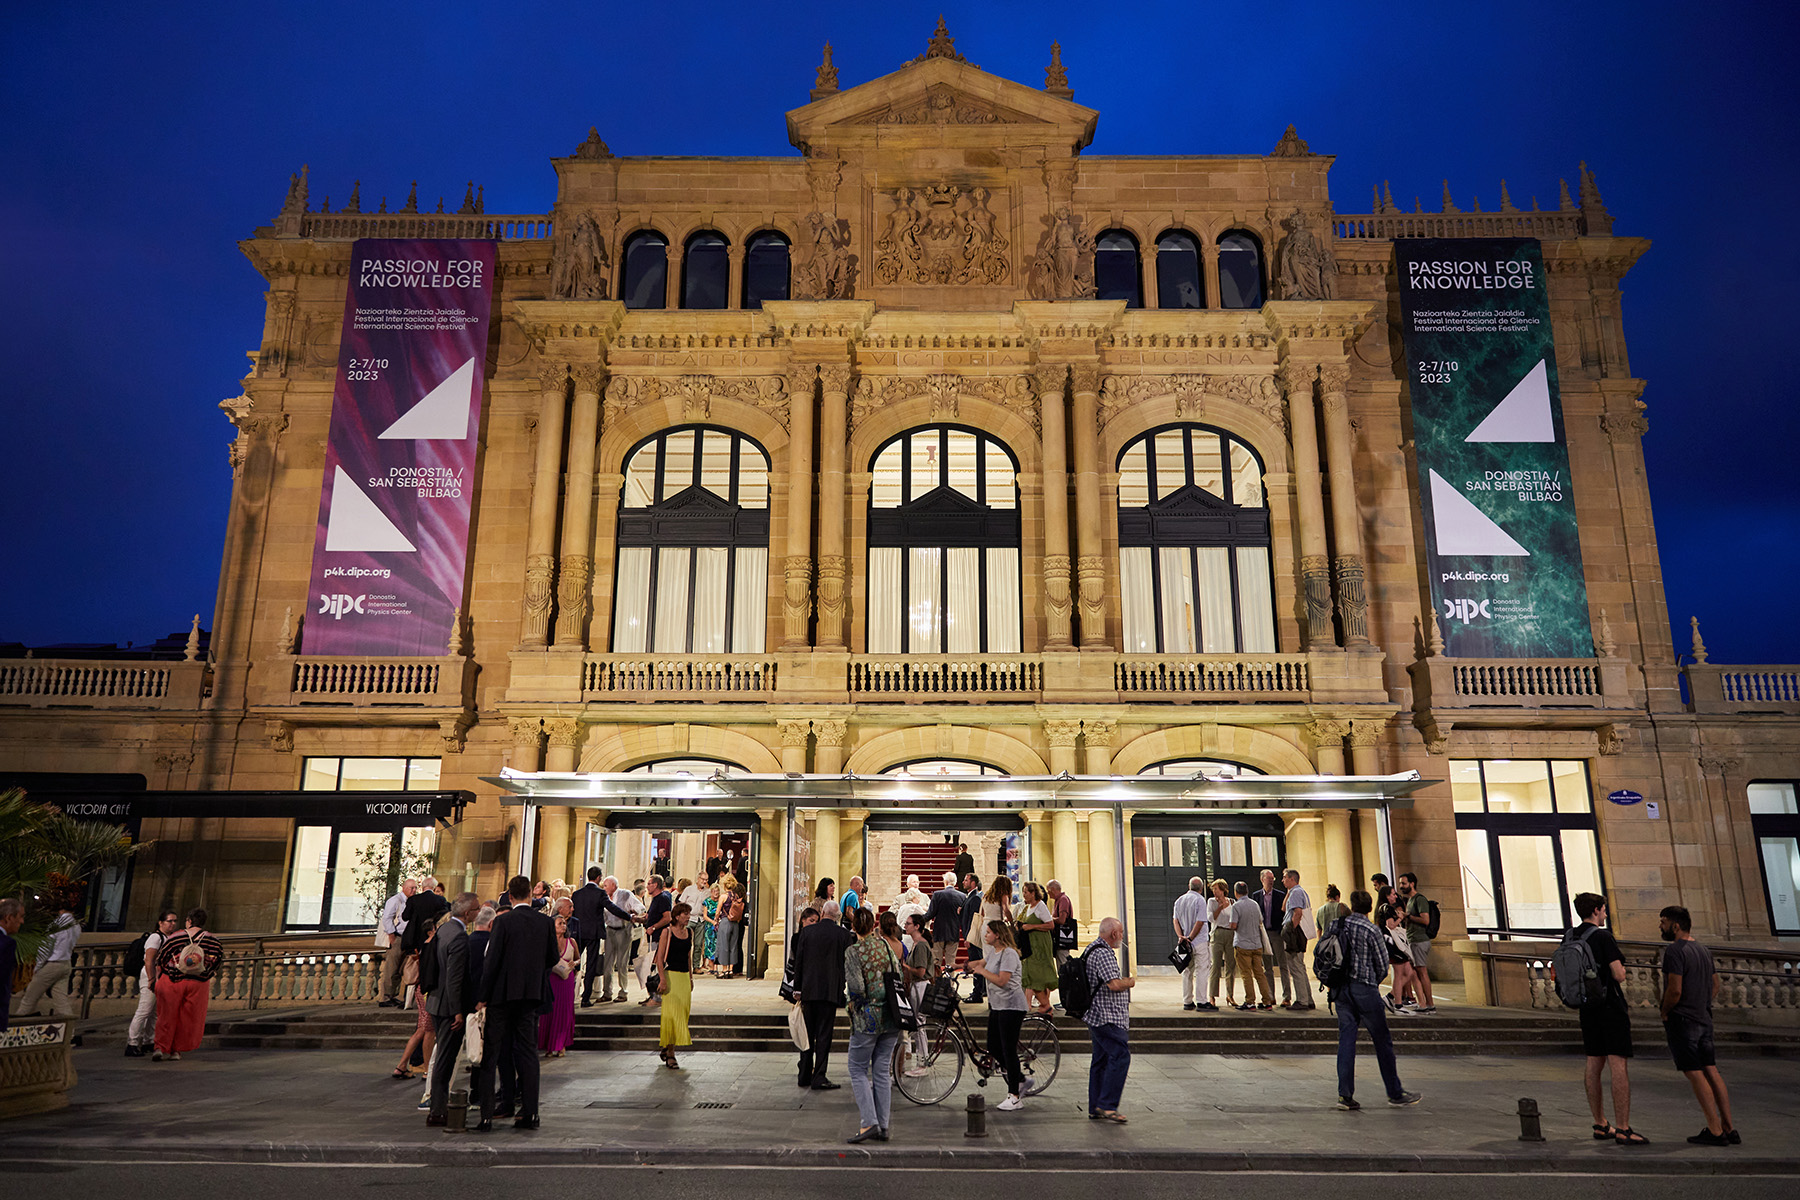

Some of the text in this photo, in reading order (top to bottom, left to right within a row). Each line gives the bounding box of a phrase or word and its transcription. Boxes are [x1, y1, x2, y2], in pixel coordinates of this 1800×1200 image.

[361, 259, 484, 273] PASSION FOR
[1408, 260, 1533, 275] PASSION FOR
[360, 274, 482, 288] KNOWLEDGE
[1410, 276, 1535, 290] KNOWLEDGE
[349, 358, 389, 370] 2-7/10
[642, 354, 758, 366] TEATRO
[871, 354, 1016, 366] VICTORIA
[1418, 361, 1459, 372] 2-7/10
[348, 370, 378, 381] 2023
[1420, 374, 1451, 384] 2023
[390, 468, 454, 478] DONOSTIA
[1484, 470, 1550, 480] DONOSTIA
[368, 476, 462, 488] SAN SEBASTIÁN
[1466, 480, 1561, 490] SAN SEBASTIÁN
[418, 488, 462, 498] BILBAO
[1518, 492, 1562, 502] BILBAO
[324, 566, 391, 578] p4k.dipc.org
[1442, 572, 1510, 583] p4k.dipc.org
[66, 802, 131, 815] VICTORIA CAFÉ
[366, 801, 431, 814] VICTORIA CAFÉ
